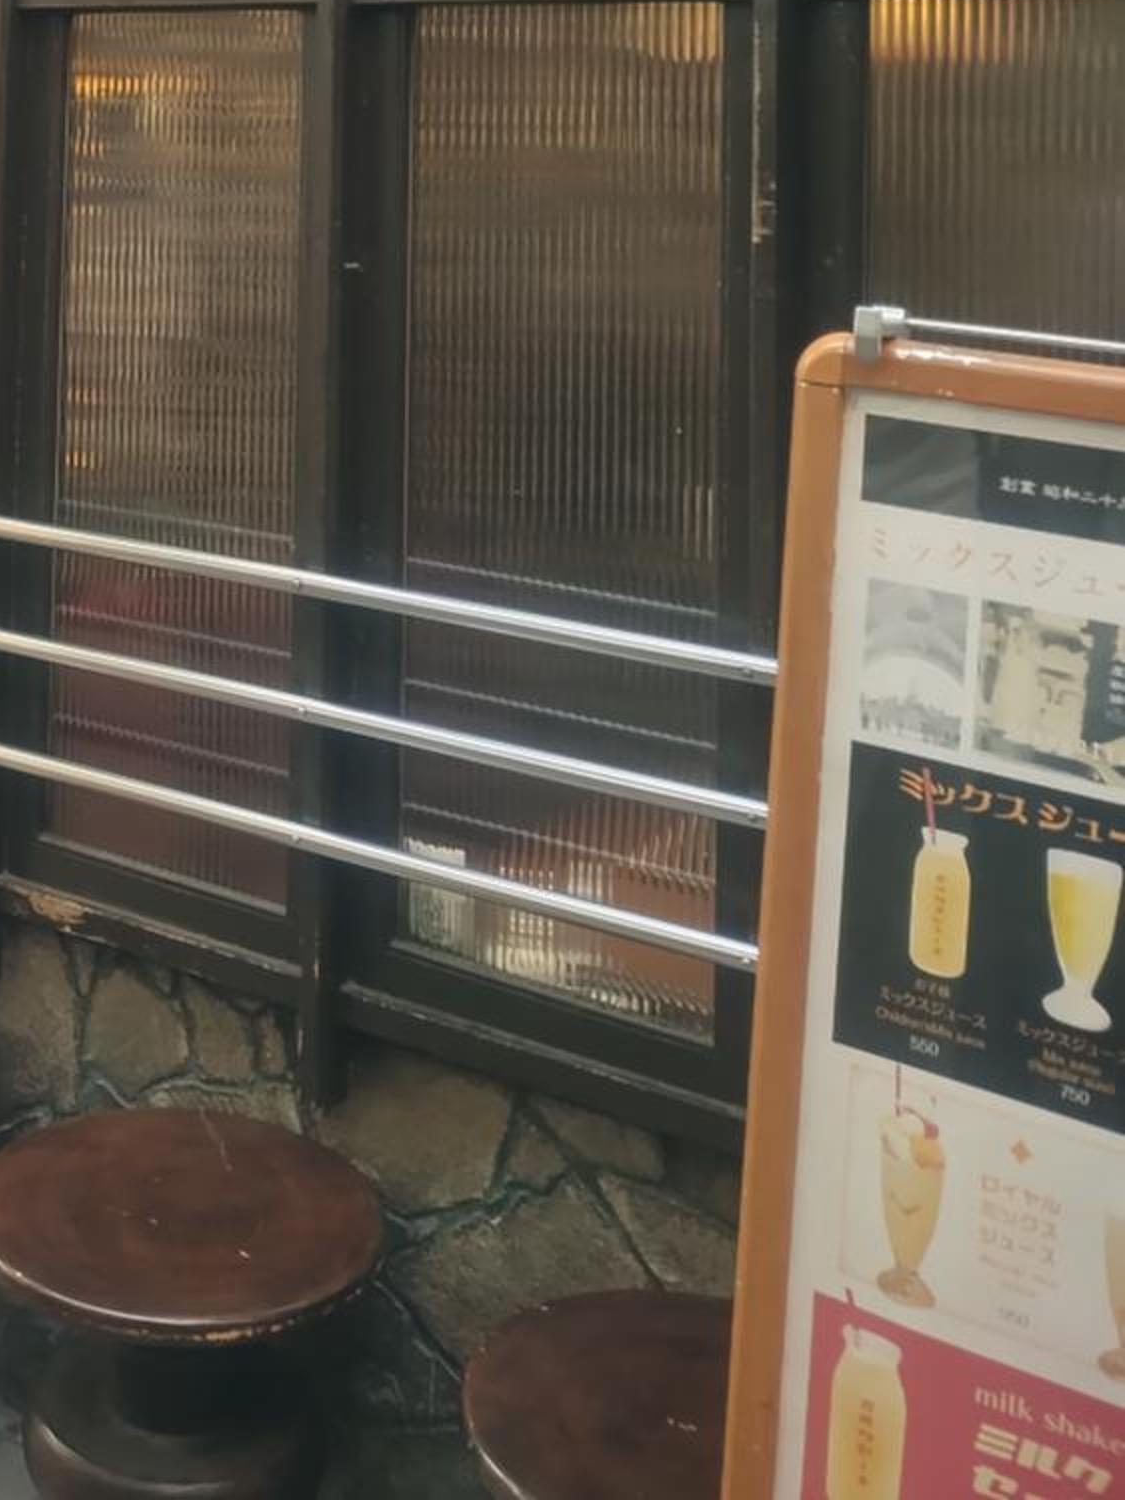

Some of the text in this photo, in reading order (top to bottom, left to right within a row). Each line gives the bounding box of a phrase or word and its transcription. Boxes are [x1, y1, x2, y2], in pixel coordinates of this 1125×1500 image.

[975, 1386, 1033, 1424] milk
[974, 1422, 1112, 1495] ミルク
